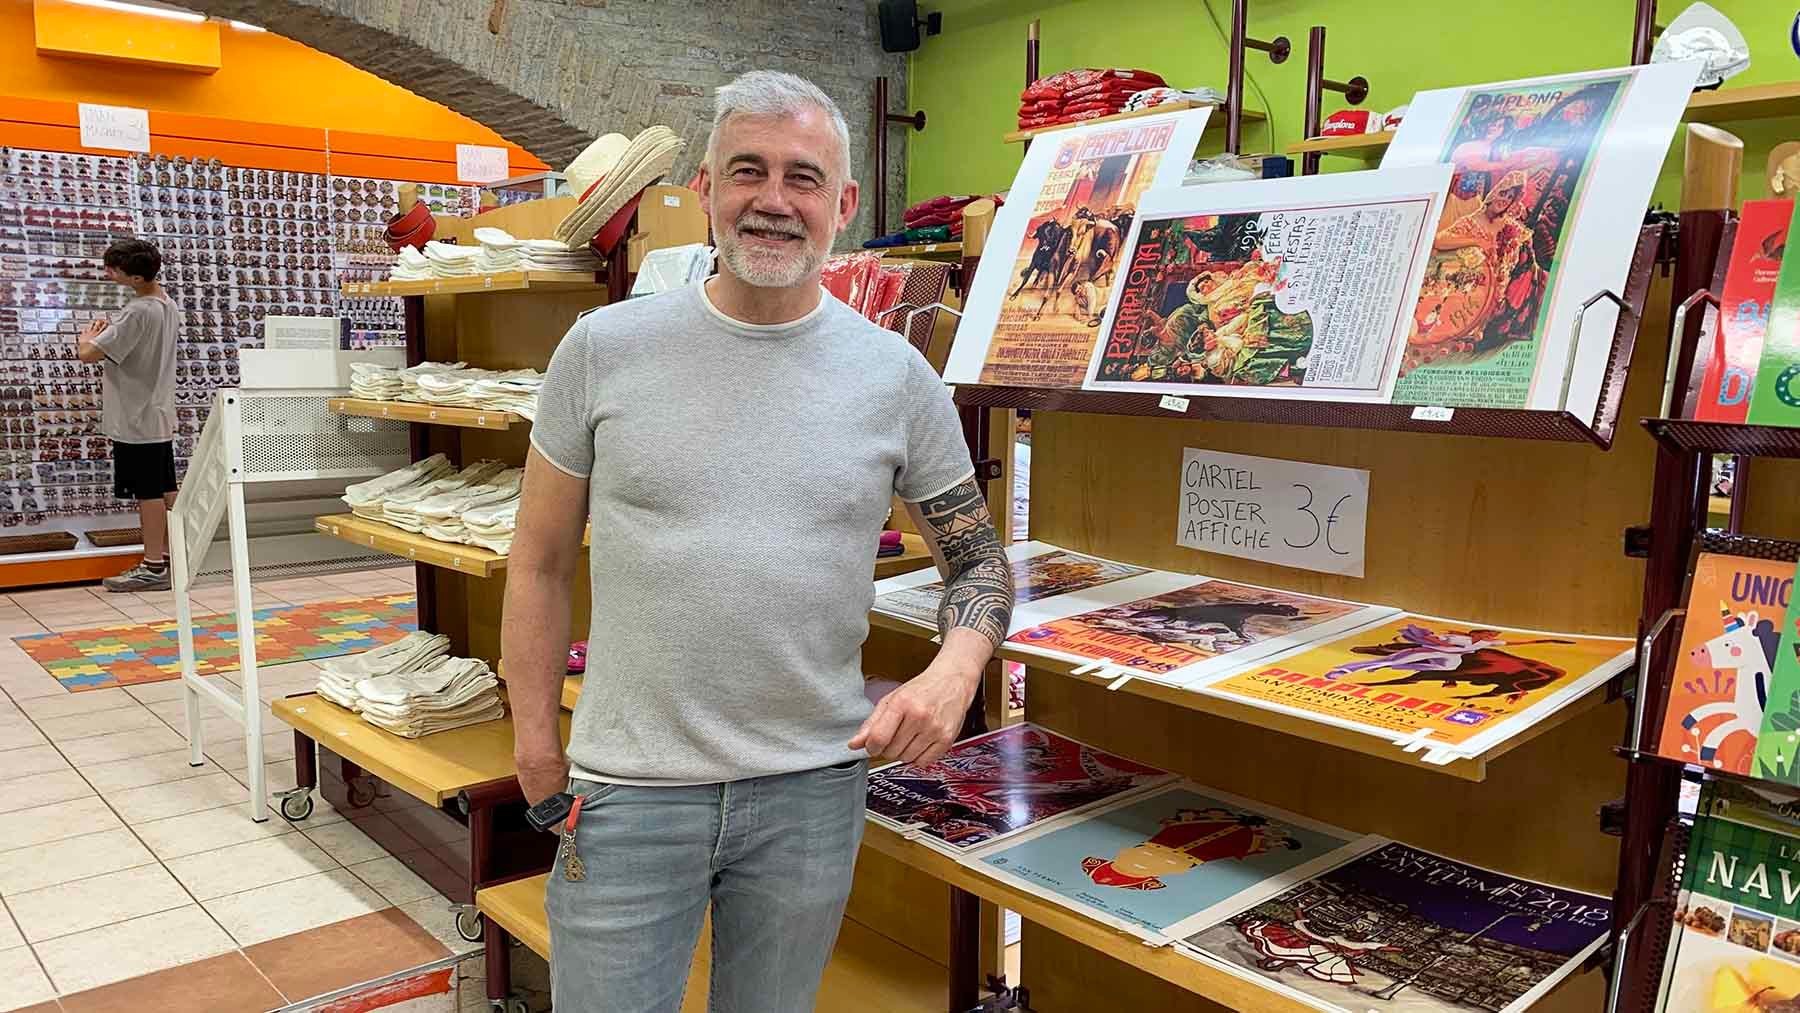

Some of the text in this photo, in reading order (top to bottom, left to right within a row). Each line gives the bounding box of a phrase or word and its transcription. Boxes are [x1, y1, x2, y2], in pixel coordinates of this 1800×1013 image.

[1264, 213, 1284, 254] FERIAS
[1185, 460, 1262, 490] CARTEL
[1184, 520, 1271, 549] AFFICHE
[1186, 484, 1352, 554] POSTER 3€
[1247, 676, 1281, 687] SAN
[1285, 683, 1352, 701] FERMIN
[1355, 698, 1375, 707] DE
[1258, 668, 1453, 714] PAMPLONA
[868, 772, 935, 804] PAMPLONA
[1528, 896, 1610, 922] 2018
